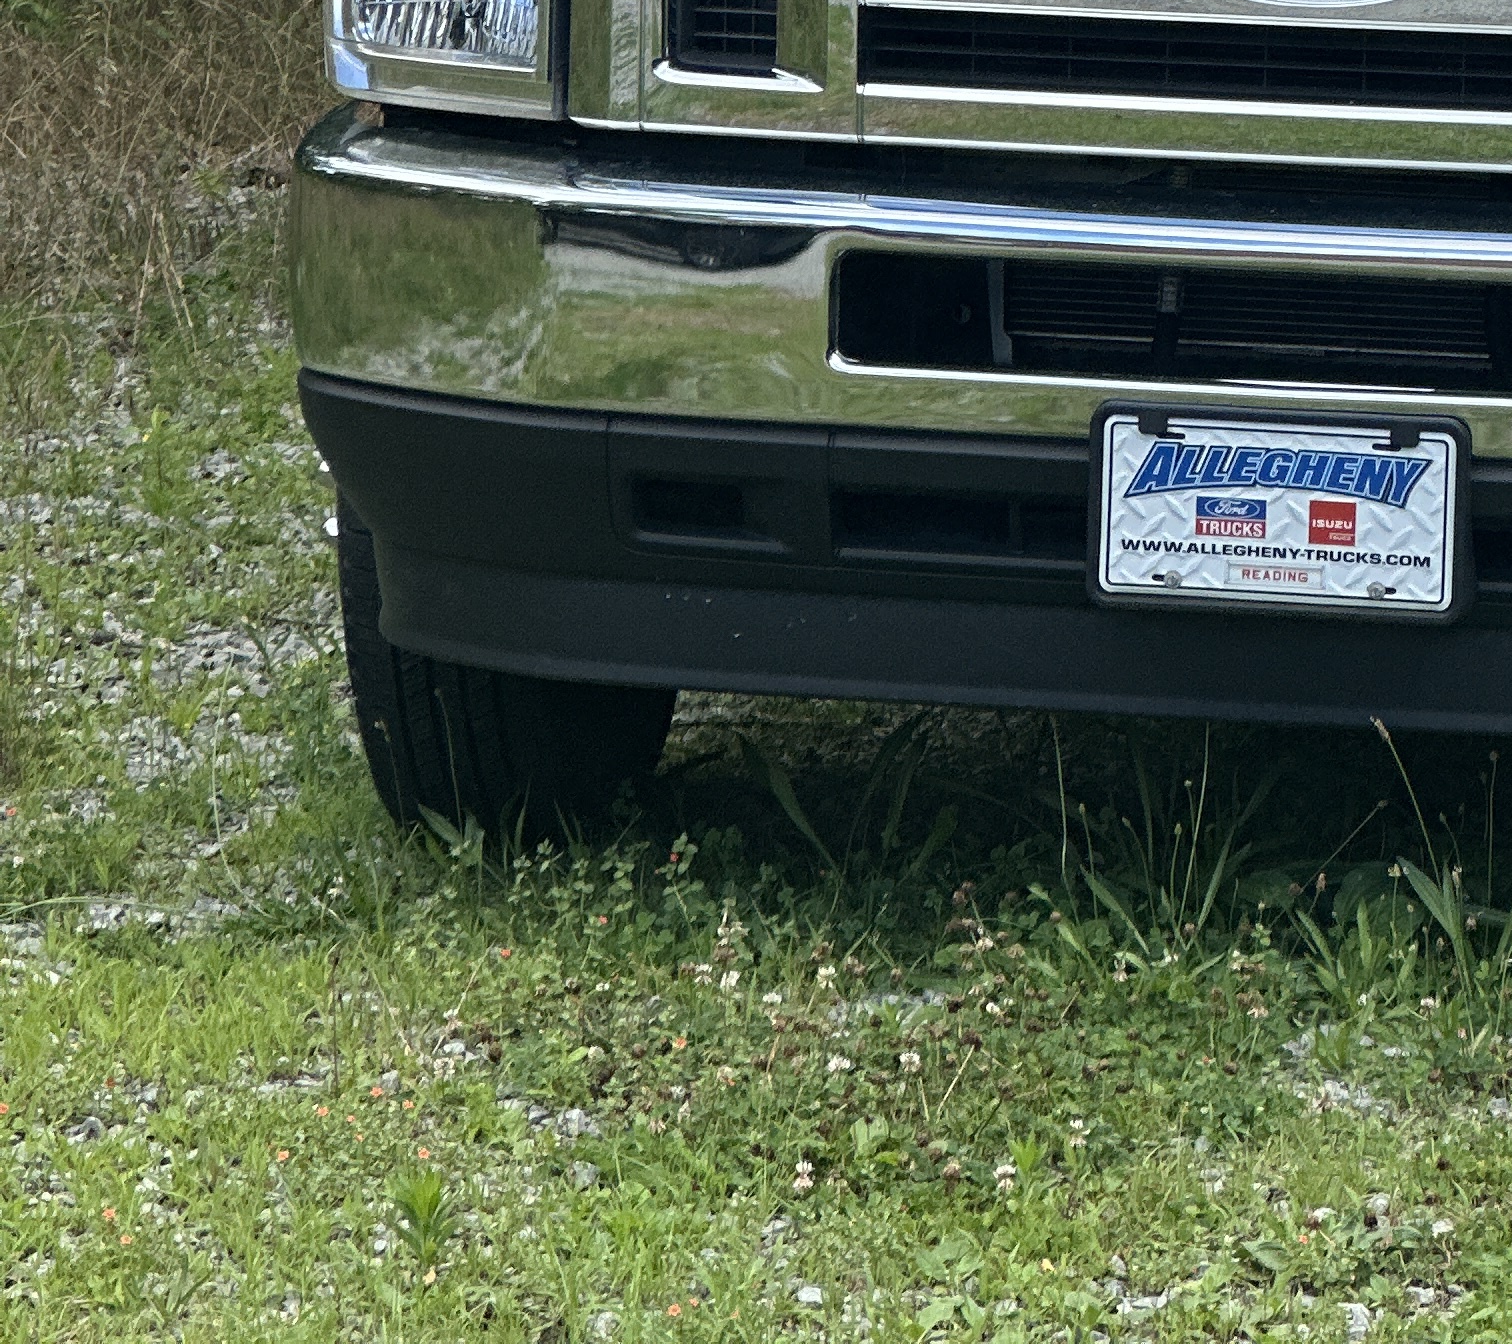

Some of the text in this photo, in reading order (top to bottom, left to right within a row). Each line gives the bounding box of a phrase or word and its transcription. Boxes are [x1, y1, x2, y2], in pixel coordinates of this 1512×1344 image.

[1123, 440, 1433, 510] ALLEGHENY
[1214, 500, 1249, 515] Ford
[1200, 520, 1263, 537] TRUCKS
[1312, 518, 1353, 530] ISUZU
[1121, 538, 1431, 568] WWW.ALLEGHENY-TRUCKS.COM
[1241, 568, 1309, 583] READING
